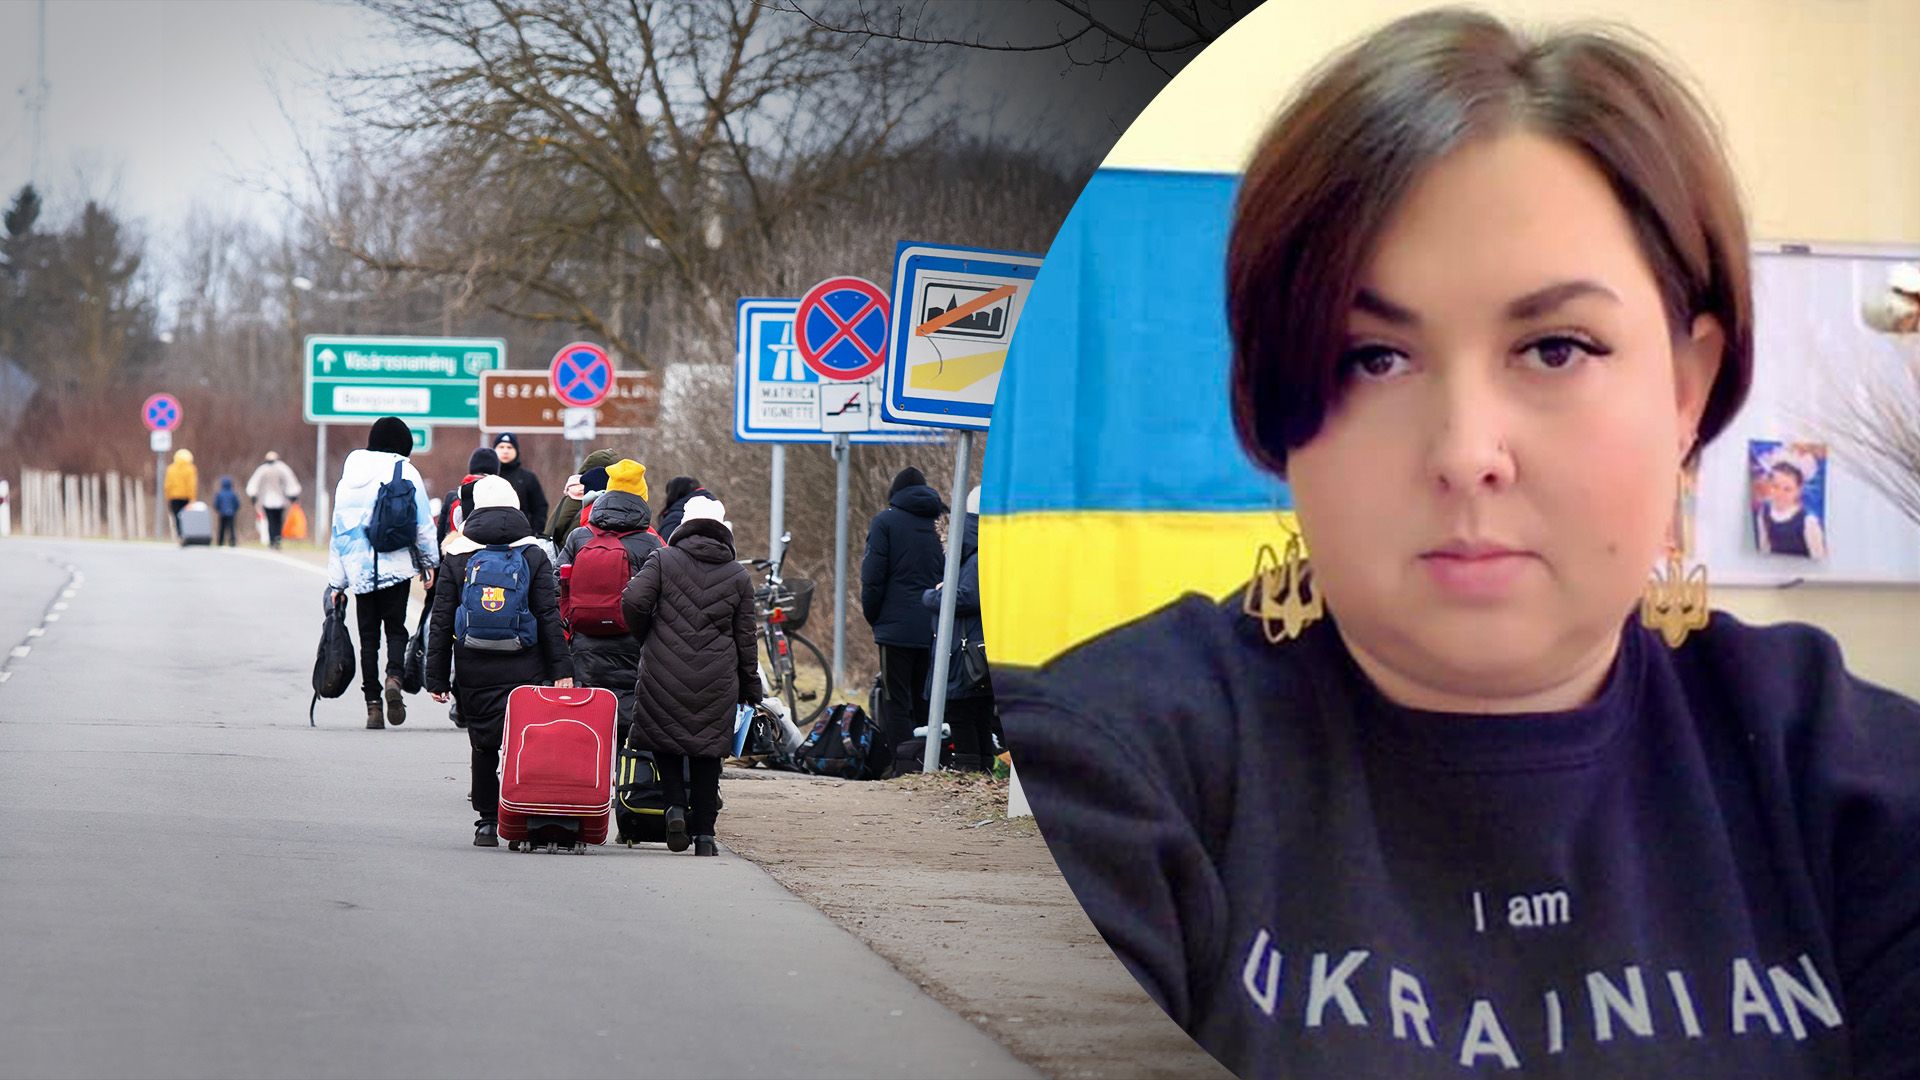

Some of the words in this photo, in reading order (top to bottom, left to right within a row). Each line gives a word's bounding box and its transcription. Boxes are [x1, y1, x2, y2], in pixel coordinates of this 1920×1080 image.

[762, 387, 815, 399] MATRICA
[761, 406, 814, 419] VIGNETTE
[1473, 892, 1486, 931] I
[1507, 889, 1571, 927] am
[1243, 928, 1844, 1069] UKRAINIAN
